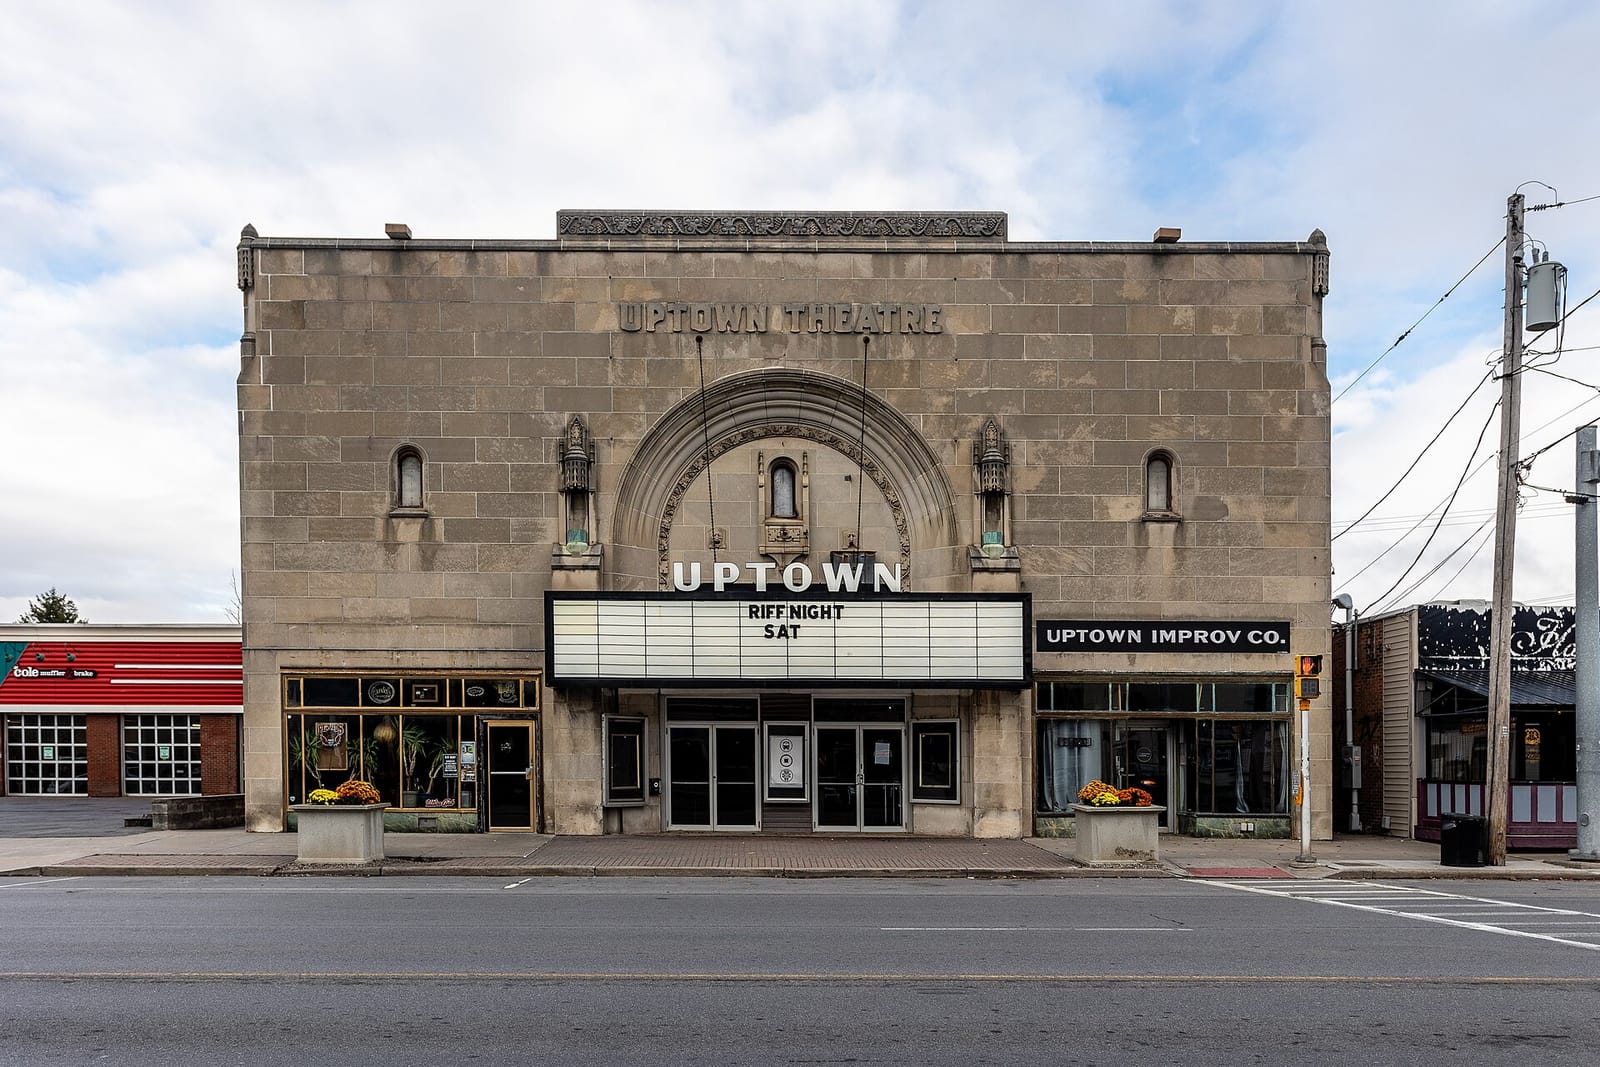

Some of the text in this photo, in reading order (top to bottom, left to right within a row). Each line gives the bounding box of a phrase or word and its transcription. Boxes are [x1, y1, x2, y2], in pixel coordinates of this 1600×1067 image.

[618, 302, 943, 334] UPTOWN THEATRE
[673, 562, 902, 593] UPTOWN
[749, 604, 845, 620] RIFF NIGHT
[764, 624, 801, 640] SAT
[1046, 629, 1287, 645] UPTOWN IMPROV CO.
[13, 666, 39, 677] cole
